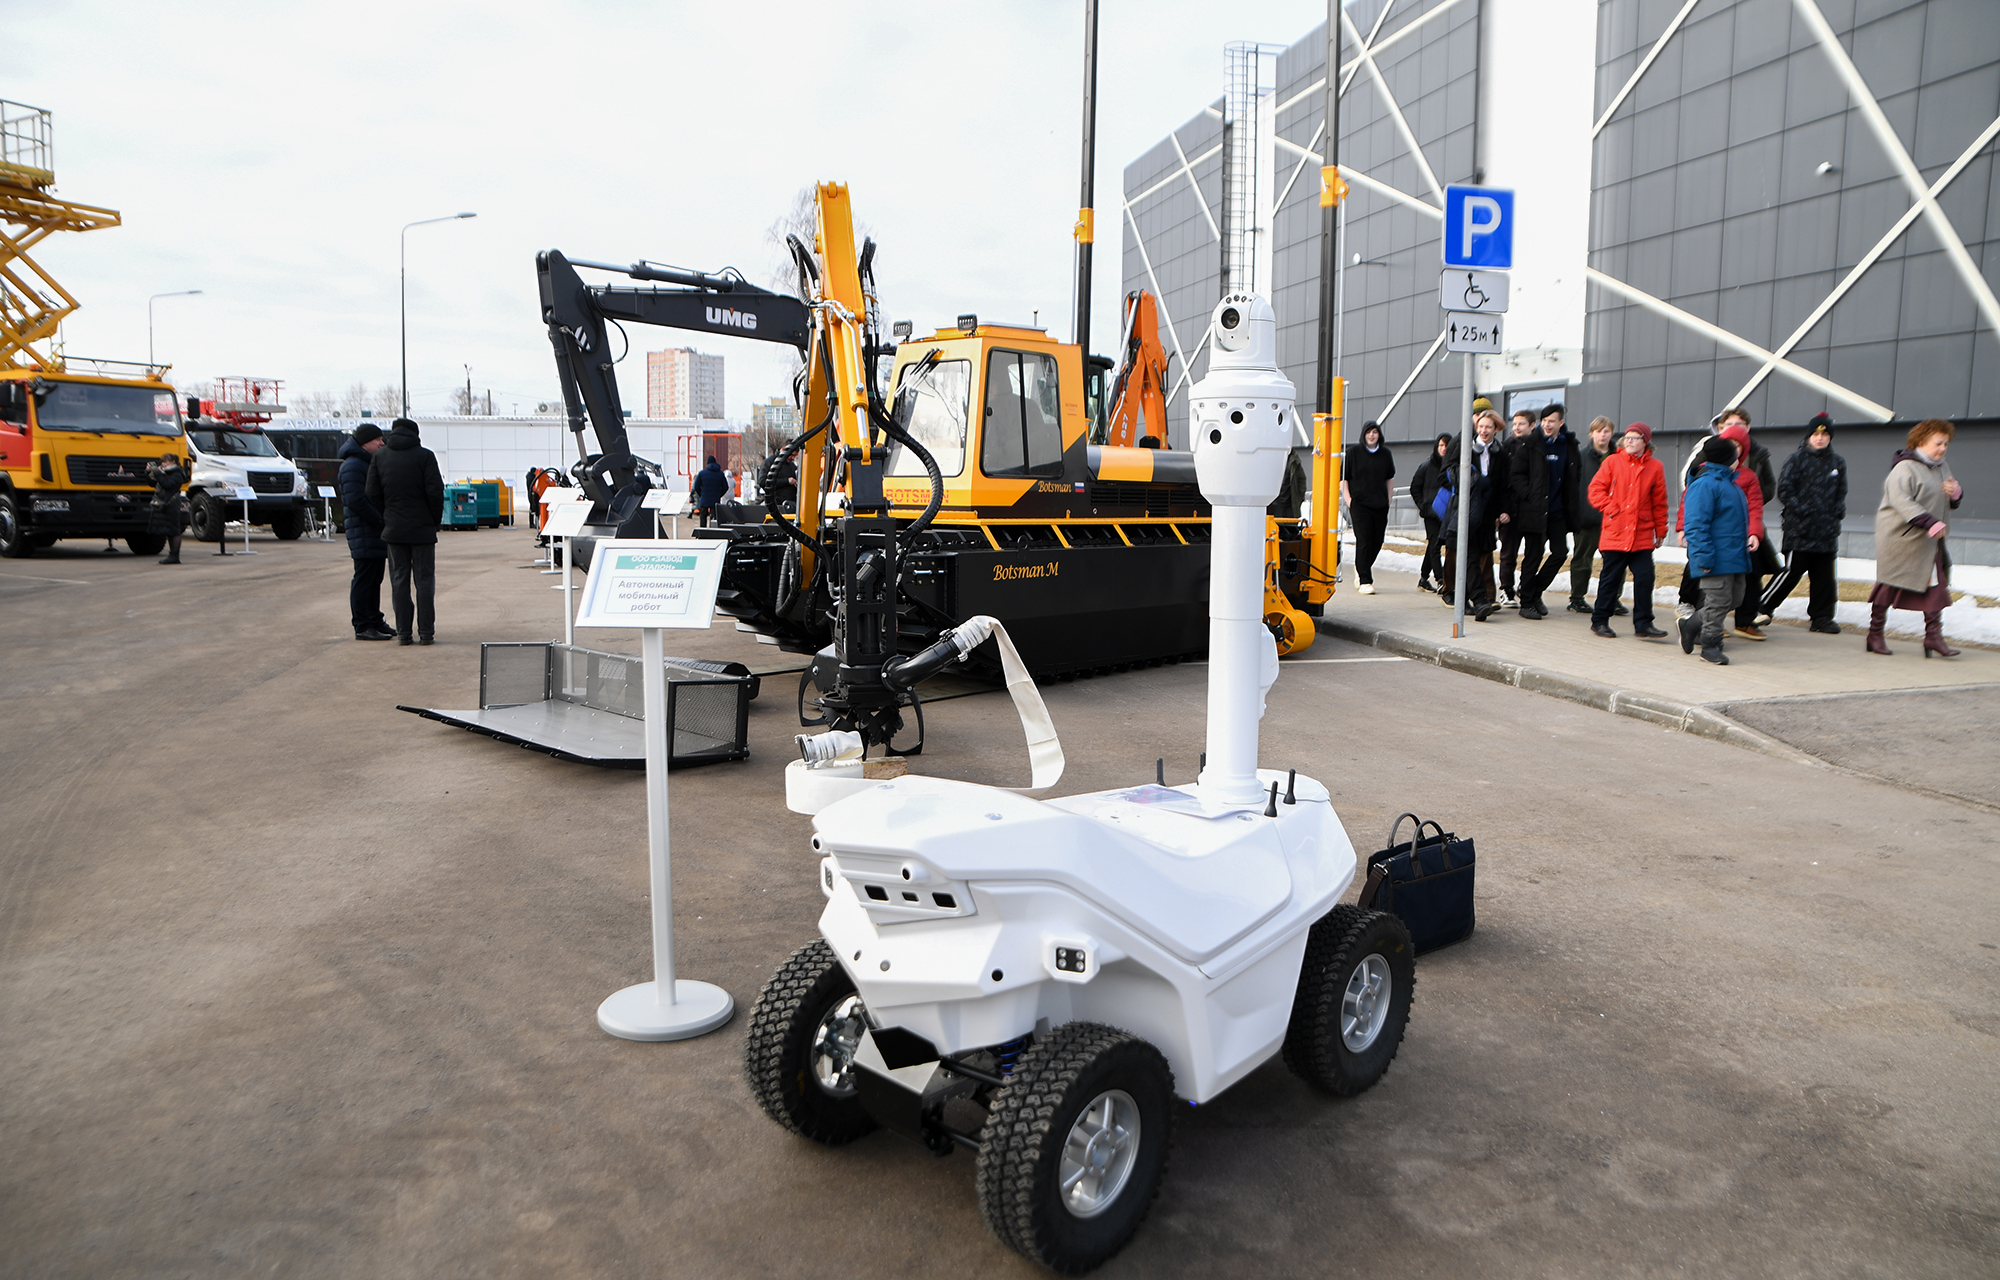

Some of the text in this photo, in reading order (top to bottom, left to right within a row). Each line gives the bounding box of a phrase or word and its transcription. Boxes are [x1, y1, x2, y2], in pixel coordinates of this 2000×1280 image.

[1463, 195, 1502, 258] P
[706, 306, 757, 330] UMG
[284, 419, 341, 430] АРМИЯ
[1038, 480, 1072, 493] Botsman
[886, 489, 949, 504] BOTSMN
[993, 561, 1059, 581] Botsman M
[618, 580, 684, 589] Автономный
[618, 591, 679, 600] мобильный
[631, 603, 661, 612] робот
